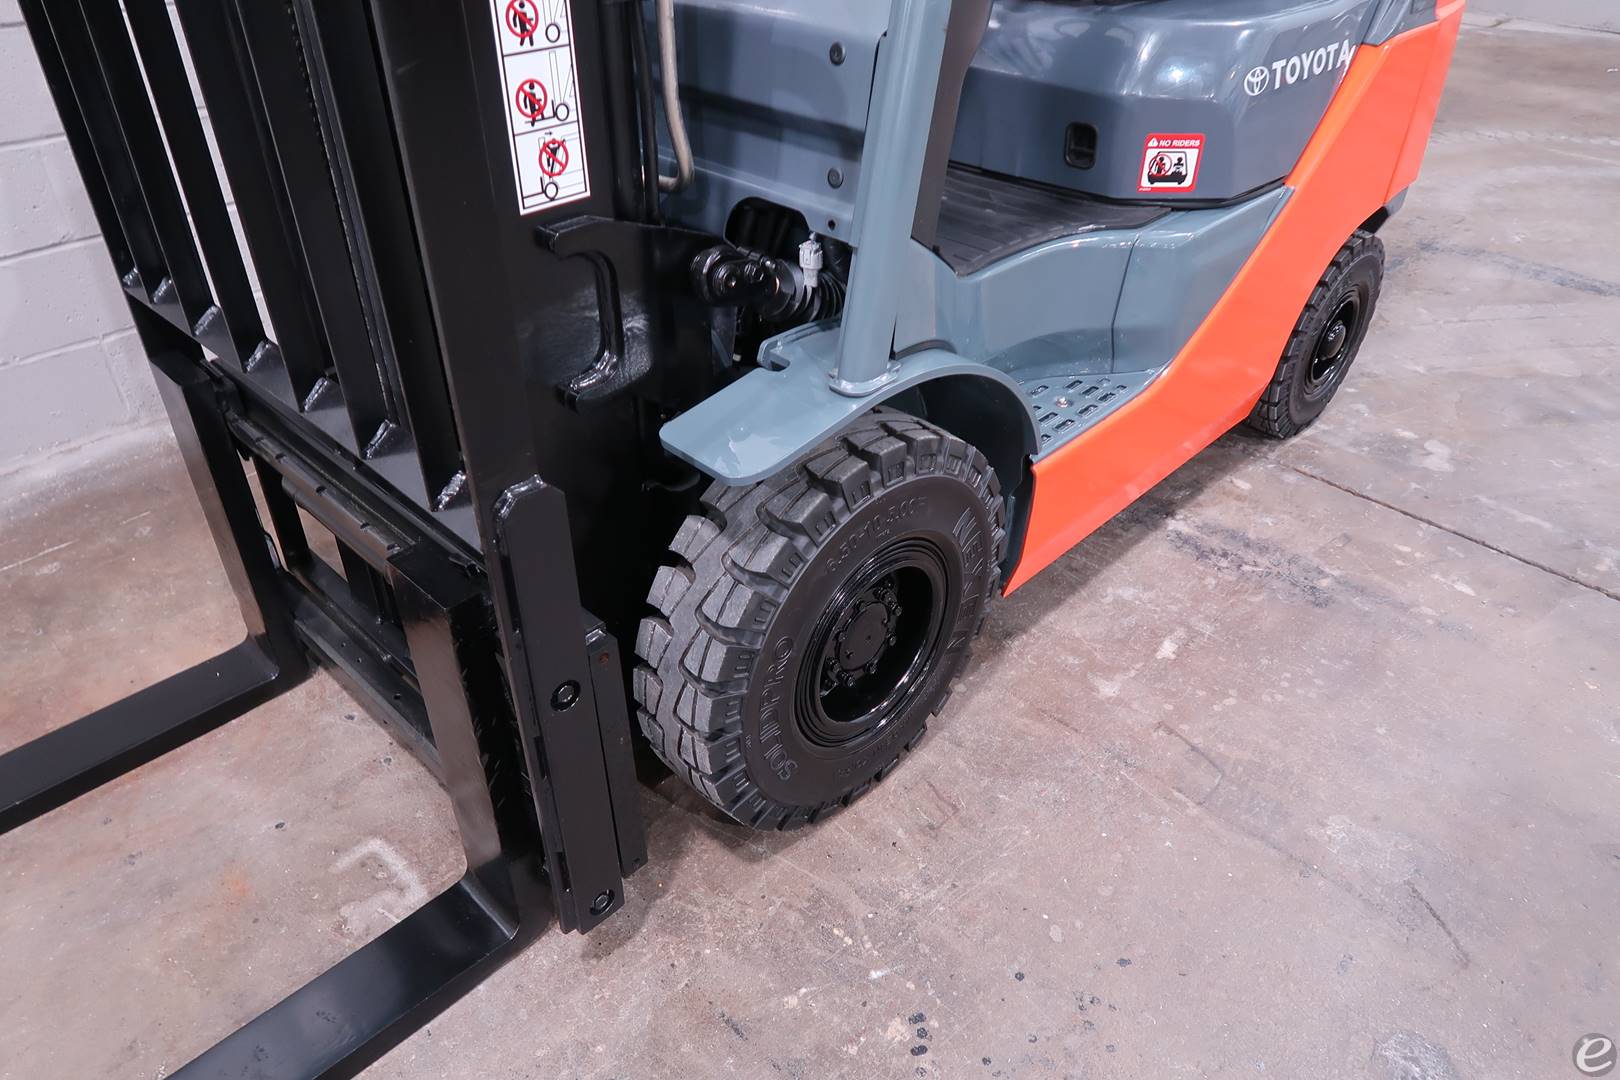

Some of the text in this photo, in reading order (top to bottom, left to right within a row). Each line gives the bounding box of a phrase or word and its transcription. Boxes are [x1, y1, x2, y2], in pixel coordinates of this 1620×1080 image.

[1272, 39, 1356, 90] TOYOTA
[1159, 139, 1201, 147] NO RIDERS
